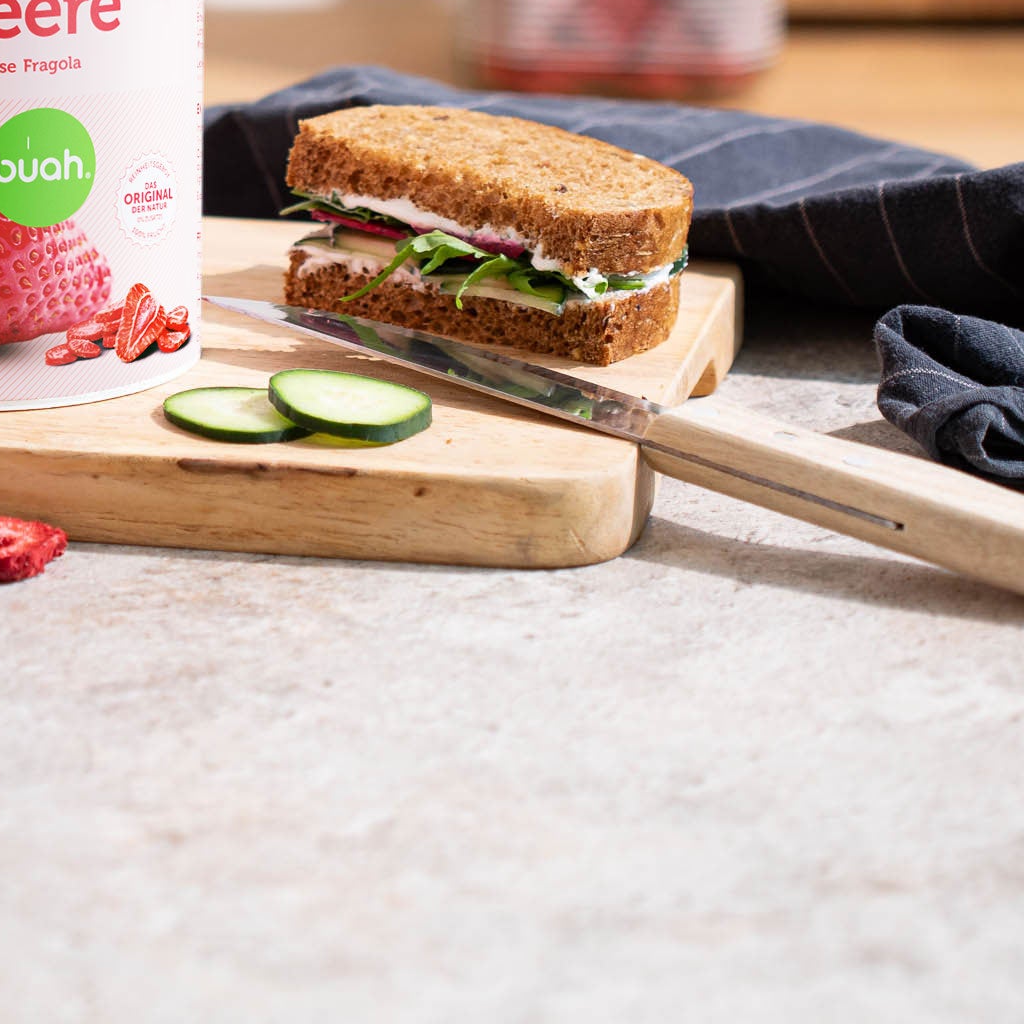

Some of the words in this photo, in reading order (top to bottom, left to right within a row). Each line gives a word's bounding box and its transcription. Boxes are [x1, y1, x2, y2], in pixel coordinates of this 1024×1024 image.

[23, 56, 82, 75] Fragola
[144, 181, 158, 190] DAS
[123, 187, 173, 206] ORIGINAL
[131, 205, 146, 214] DER
[147, 202, 168, 212] NATUR
